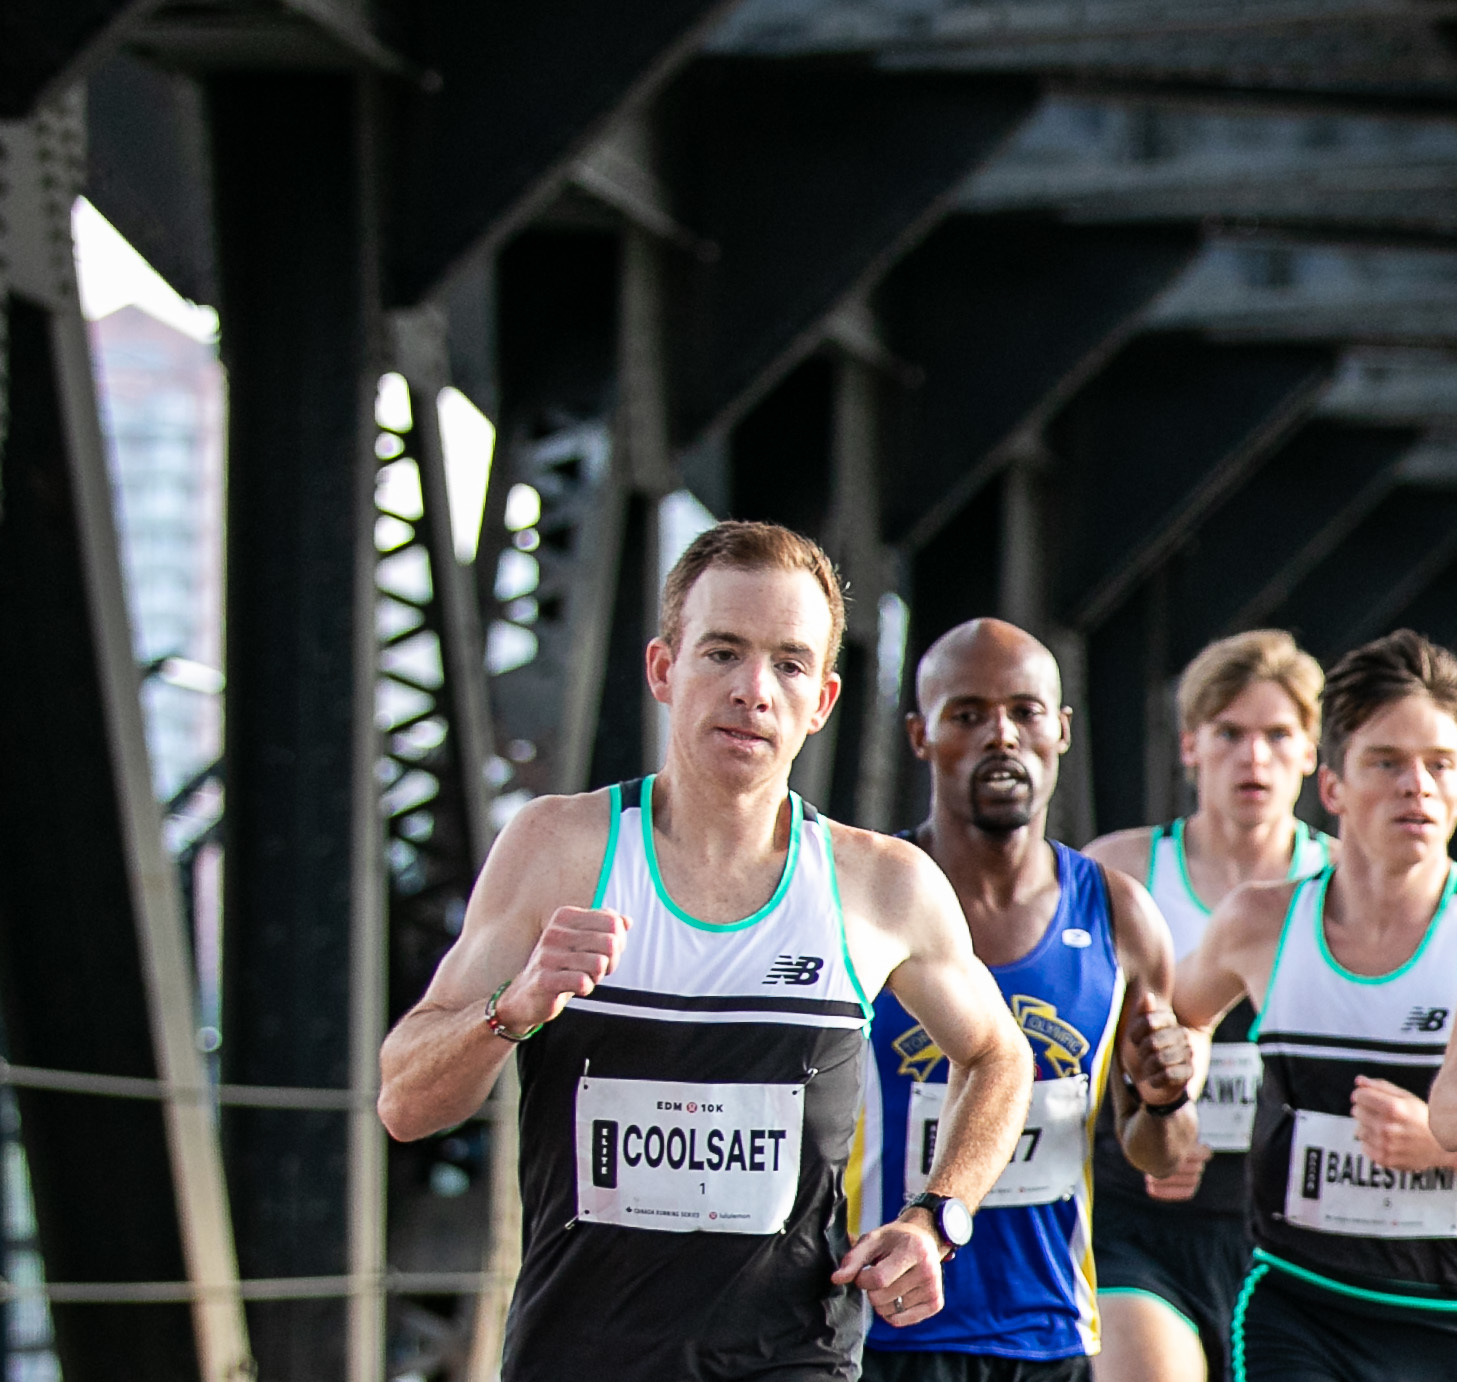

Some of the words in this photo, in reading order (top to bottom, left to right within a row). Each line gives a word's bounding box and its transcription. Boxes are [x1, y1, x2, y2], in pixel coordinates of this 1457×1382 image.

[1027, 1014, 1082, 1055] OLYMPIC
[656, 1101, 682, 1111] EDM
[701, 1103, 724, 1113] 10K
[601, 1128, 609, 1175] ELITE
[622, 1124, 787, 1172] COOLSAET
[699, 1182, 706, 1195] 1
